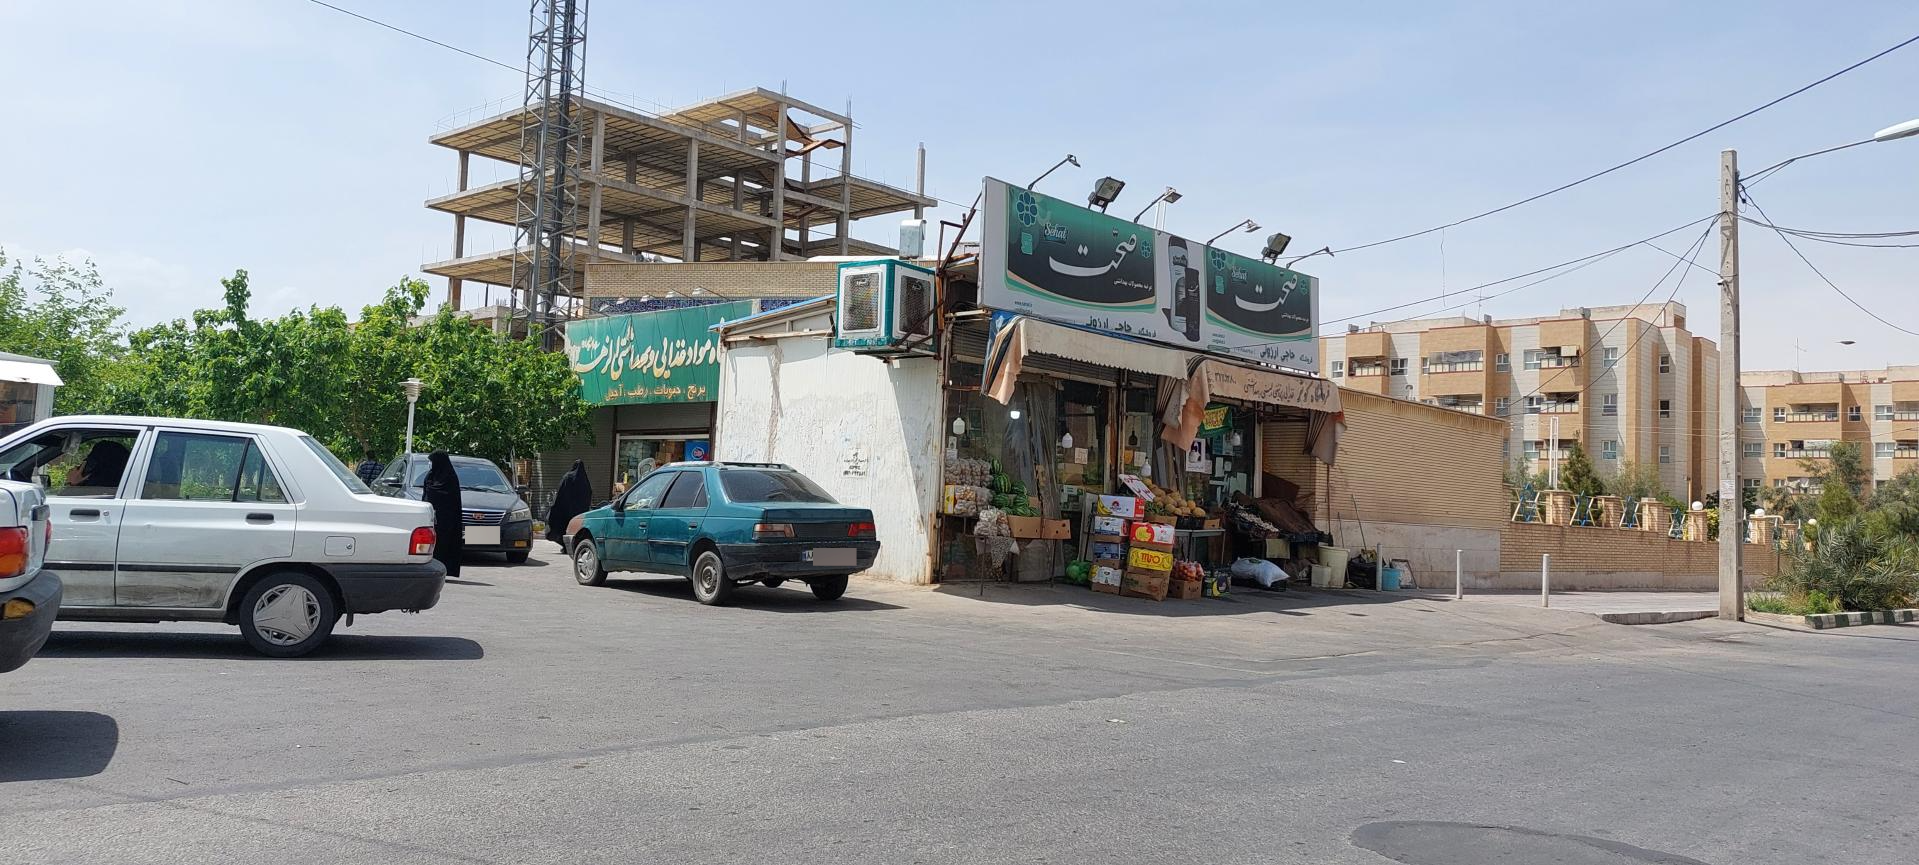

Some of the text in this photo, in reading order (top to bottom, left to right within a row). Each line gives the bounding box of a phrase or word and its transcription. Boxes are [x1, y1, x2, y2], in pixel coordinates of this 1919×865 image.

[653, 336, 687, 379] غذایی
[685, 338, 711, 366] مواد
[627, 384, 648, 398] رطب
[654, 384, 681, 399] حبوبات
[687, 384, 706, 399] برنج
